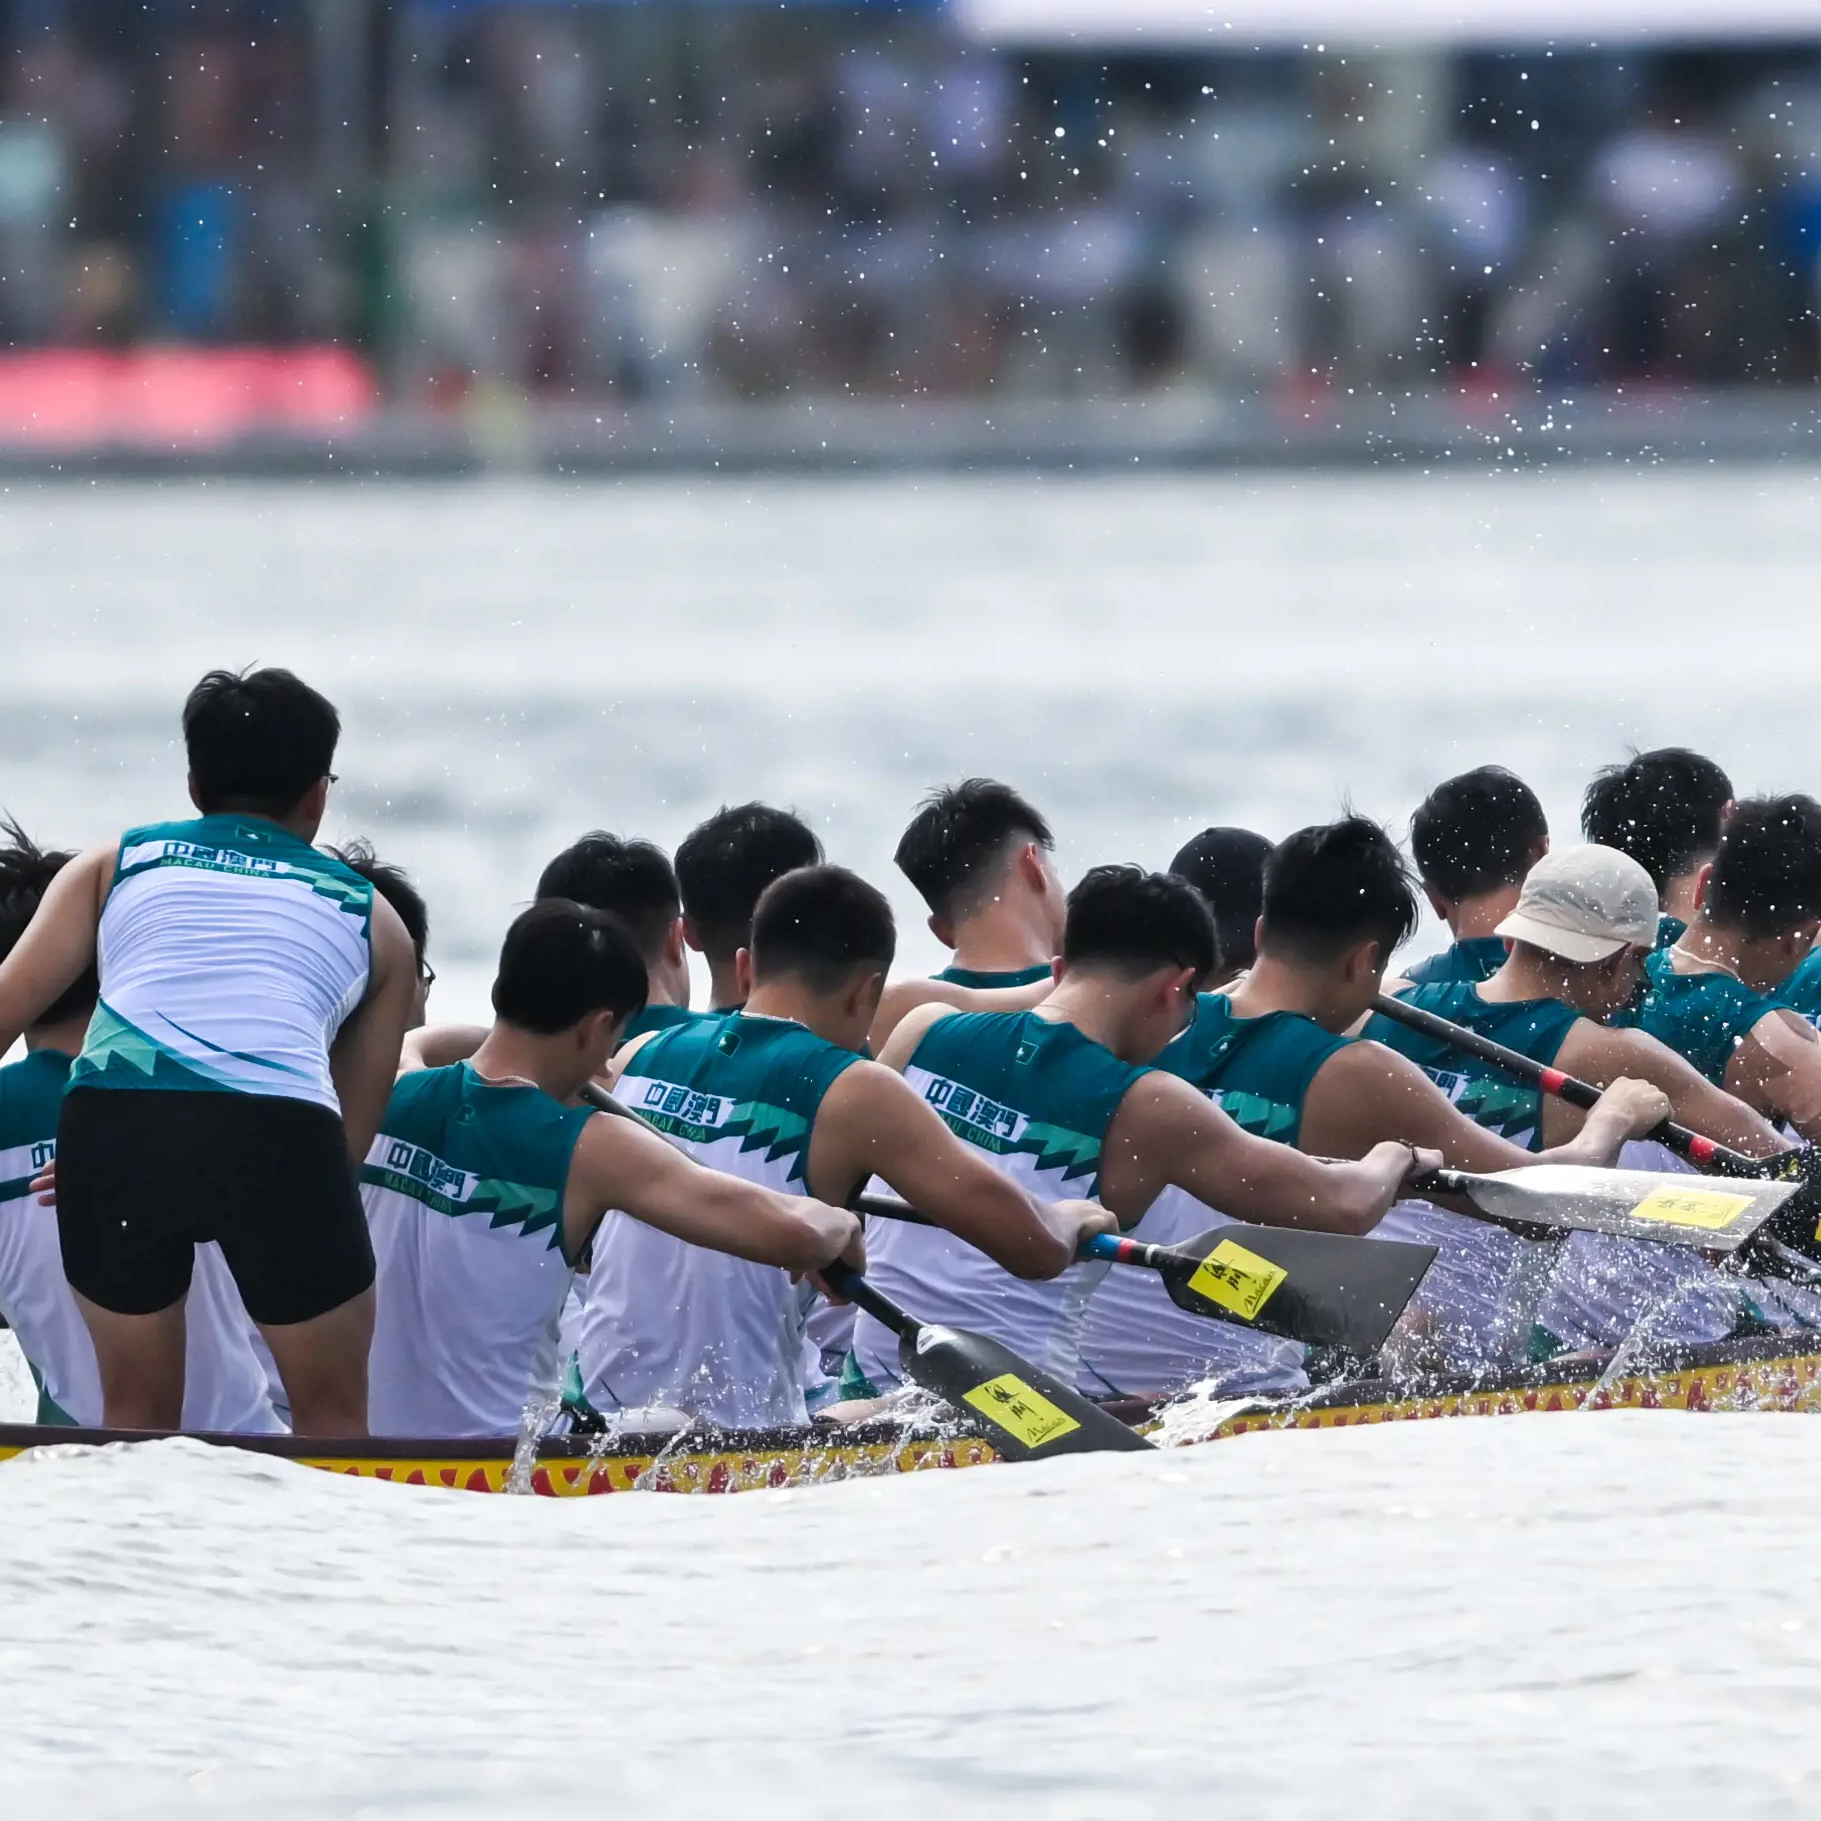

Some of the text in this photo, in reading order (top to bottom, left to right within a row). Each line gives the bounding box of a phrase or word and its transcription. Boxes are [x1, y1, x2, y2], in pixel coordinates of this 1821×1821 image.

[160, 857, 271, 878] MACAU CHINA
[643, 1082, 722, 1125] 中國澳門
[924, 1077, 1019, 1138] 中國澳門
